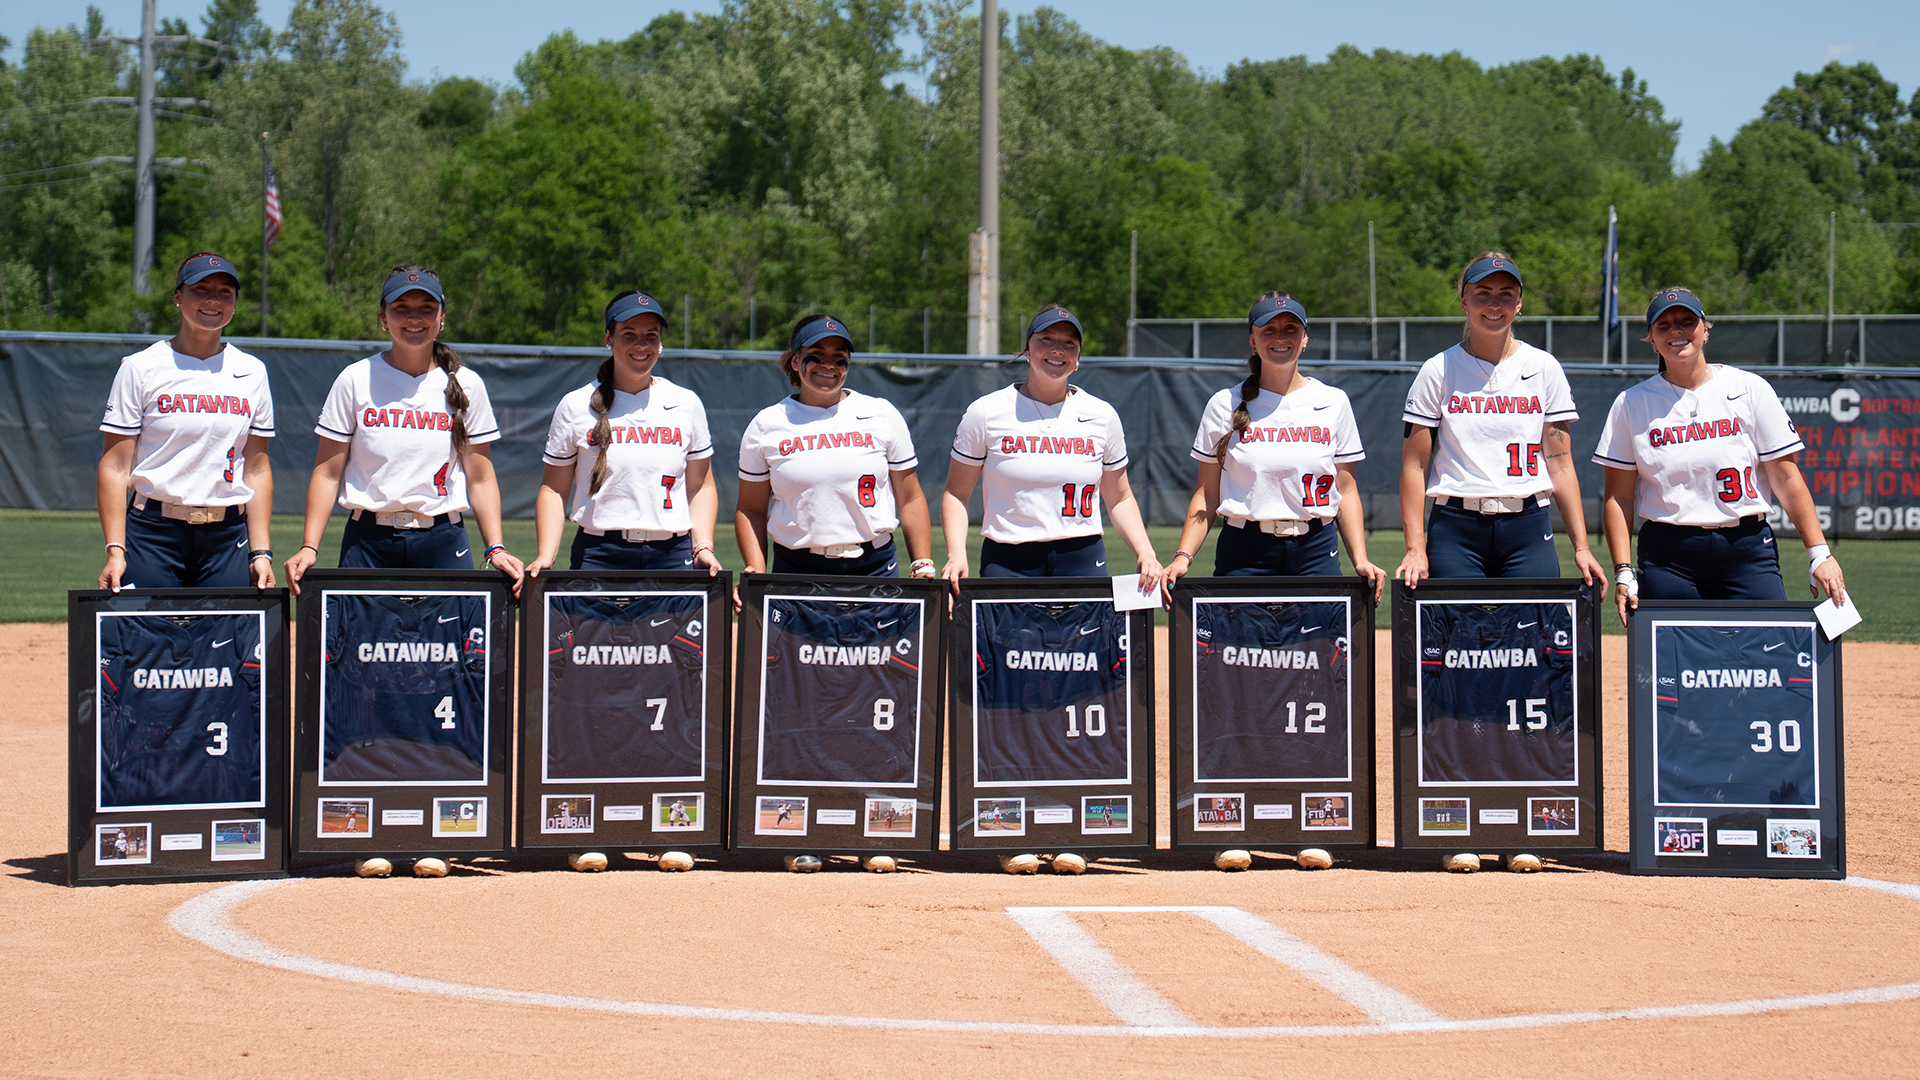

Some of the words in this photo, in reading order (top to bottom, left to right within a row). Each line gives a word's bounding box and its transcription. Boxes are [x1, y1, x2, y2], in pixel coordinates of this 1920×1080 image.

[157, 394, 251, 418] CATAWBA
[1448, 396, 1542, 413] CATAWBA
[1778, 396, 1830, 413] AWBA
[1830, 388, 1861, 422] C
[779, 431, 875, 456] CATAWBA
[1240, 426, 1331, 446] CATAWBA
[1650, 418, 1742, 447] CATAWBA
[1831, 427, 1920, 447] ATLANT
[1002, 436, 1096, 457] CATAWBA
[1507, 443, 1540, 476] 15
[661, 475, 676, 509] 7
[858, 474, 876, 508] 8
[1302, 473, 1334, 507] 12
[1716, 466, 1758, 503] 30
[1062, 483, 1095, 517] 10
[1766, 505, 1831, 531] 25
[1855, 506, 1920, 532] 2016
[469, 627, 484, 644] C
[686, 620, 702, 637] C
[1554, 630, 1568, 646] C
[358, 642, 458, 662] CATAWBA
[572, 644, 672, 665] CATAWBA
[799, 644, 891, 666] CATAWBA
[895, 638, 912, 655] C
[1223, 646, 1319, 670] CATAWBA
[1445, 648, 1538, 669] CATAWBA
[1005, 650, 1098, 671] CATAWBA
[1797, 652, 1811, 667] C
[133, 667, 233, 690] CATAWBA
[1681, 668, 1783, 688] CATAWBA
[434, 696, 455, 729] 4
[646, 698, 667, 731] 7
[873, 698, 895, 731] 8
[1065, 704, 1106, 737] 10
[1285, 701, 1326, 733] 12
[1506, 698, 1548, 731] 15
[206, 722, 228, 756] 3
[1750, 719, 1801, 753] 30
[460, 803, 474, 820] C
[1309, 809, 1339, 819] FTBL
[1675, 833, 1704, 849] OF
